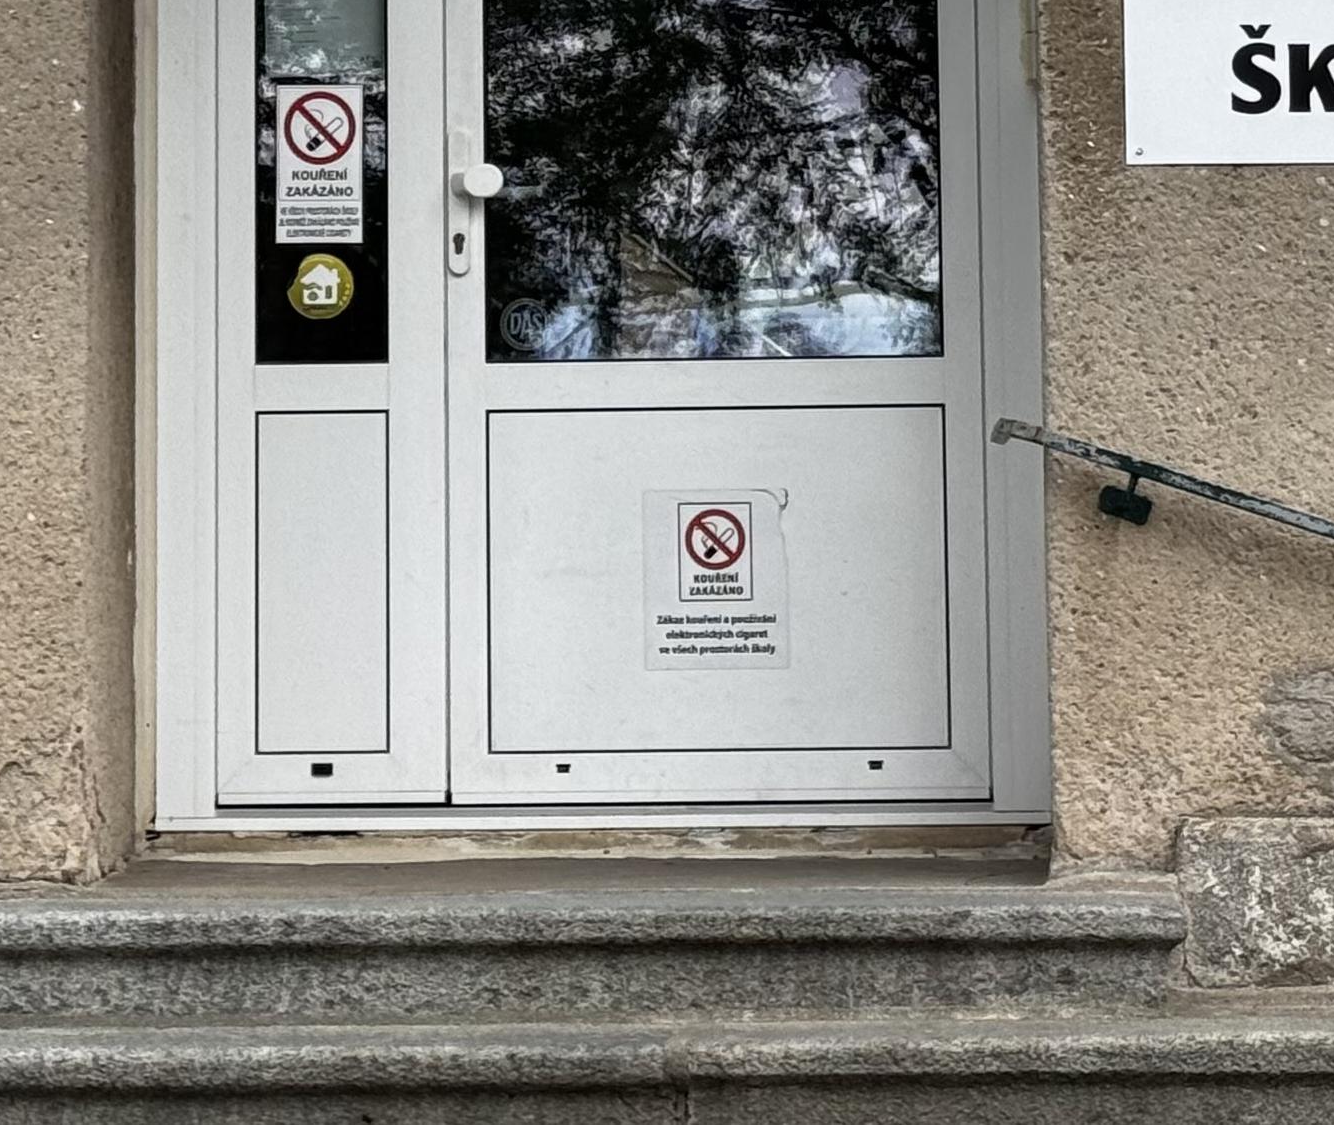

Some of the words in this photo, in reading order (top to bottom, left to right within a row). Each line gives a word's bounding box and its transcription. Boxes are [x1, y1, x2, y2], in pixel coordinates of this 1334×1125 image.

[291, 168, 348, 181] KOUŘENÍ
[285, 185, 354, 197] ZAKÁZÁNO
[693, 572, 739, 584] KOUŘENÍ
[689, 585, 744, 596] ZAKÁZÁNO
